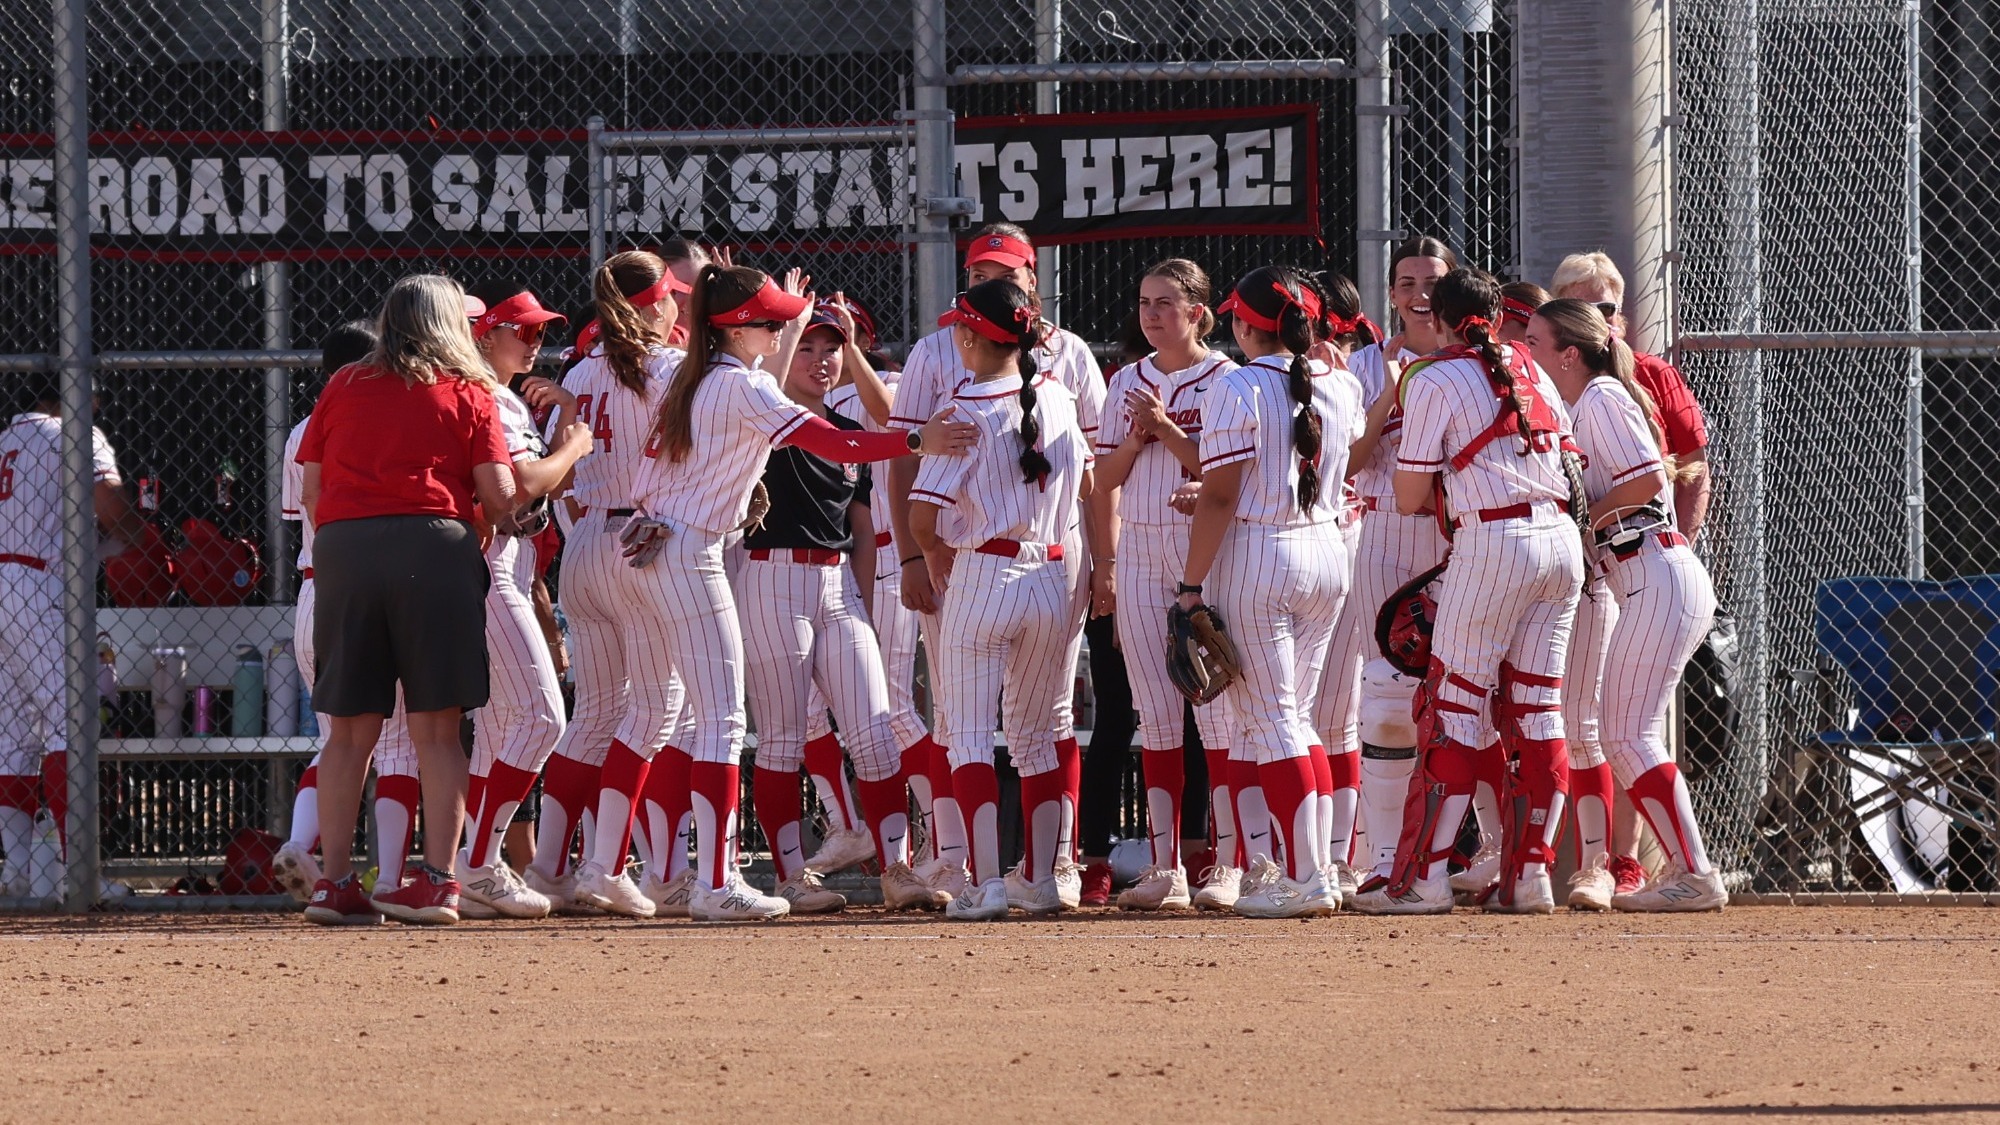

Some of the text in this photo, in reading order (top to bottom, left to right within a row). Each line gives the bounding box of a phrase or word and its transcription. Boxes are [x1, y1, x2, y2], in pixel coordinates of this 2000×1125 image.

[0, 159, 57, 229] E
[87, 157, 286, 235] ROAD
[308, 154, 413, 232] TO
[432, 155, 708, 232] SALEM
[1061, 127, 1292, 218] HERE!
[486, 313, 498, 325] GC
[737, 310, 750, 320] GC
